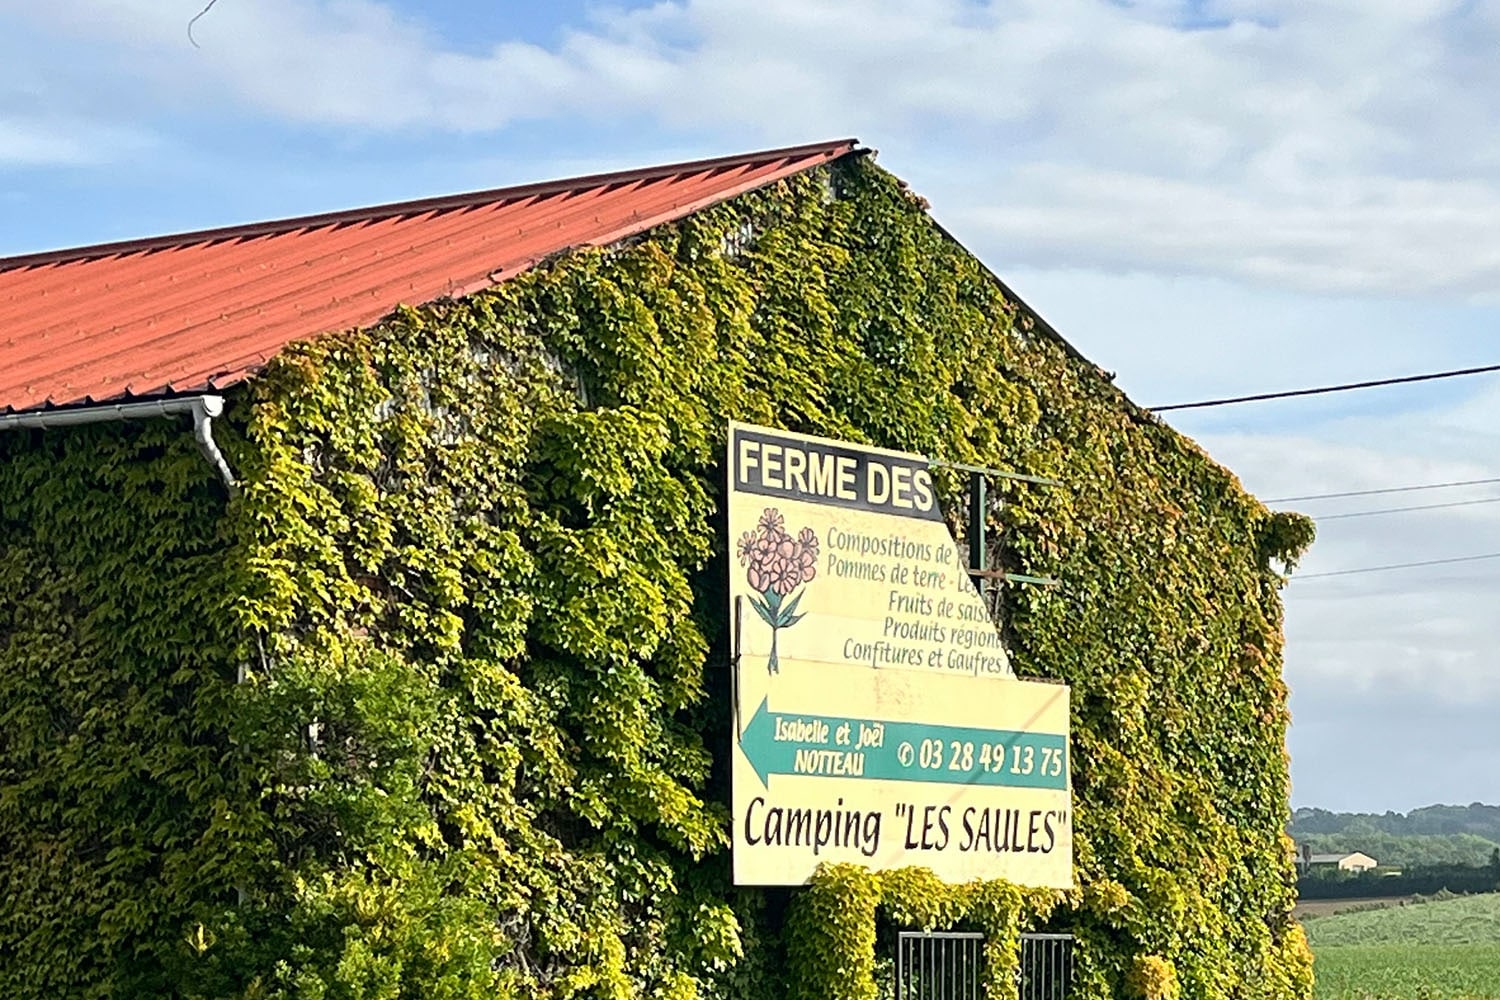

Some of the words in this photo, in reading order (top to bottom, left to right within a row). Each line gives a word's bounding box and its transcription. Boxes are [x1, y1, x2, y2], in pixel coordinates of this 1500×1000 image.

[739, 439, 857, 501] FERME
[867, 461, 934, 512] DES
[827, 526, 932, 562] Compositions
[935, 543, 953, 566] de
[827, 553, 887, 583] Pommes
[890, 563, 909, 585] de
[913, 566, 946, 590] terre
[888, 590, 933, 617] Fruits
[937, 596, 954, 619] de
[883, 616, 946, 644] Produits
[843, 637, 923, 669] Confitures
[928, 647, 944, 668] et
[947, 648, 1001, 676] Gaufres
[774, 716, 830, 745] Isabelle
[835, 722, 852, 746] et
[855, 721, 885, 751] Joël
[794, 748, 865, 777] NOTTEAU
[919, 738, 944, 770] 03
[948, 740, 975, 772] 28
[978, 742, 1006, 774] 49
[1009, 745, 1035, 775] 13
[1040, 747, 1063, 777] 75
[743, 796, 882, 857] Camping
[895, 803, 952, 852] "LES
[959, 807, 1067, 854] SAULES"
